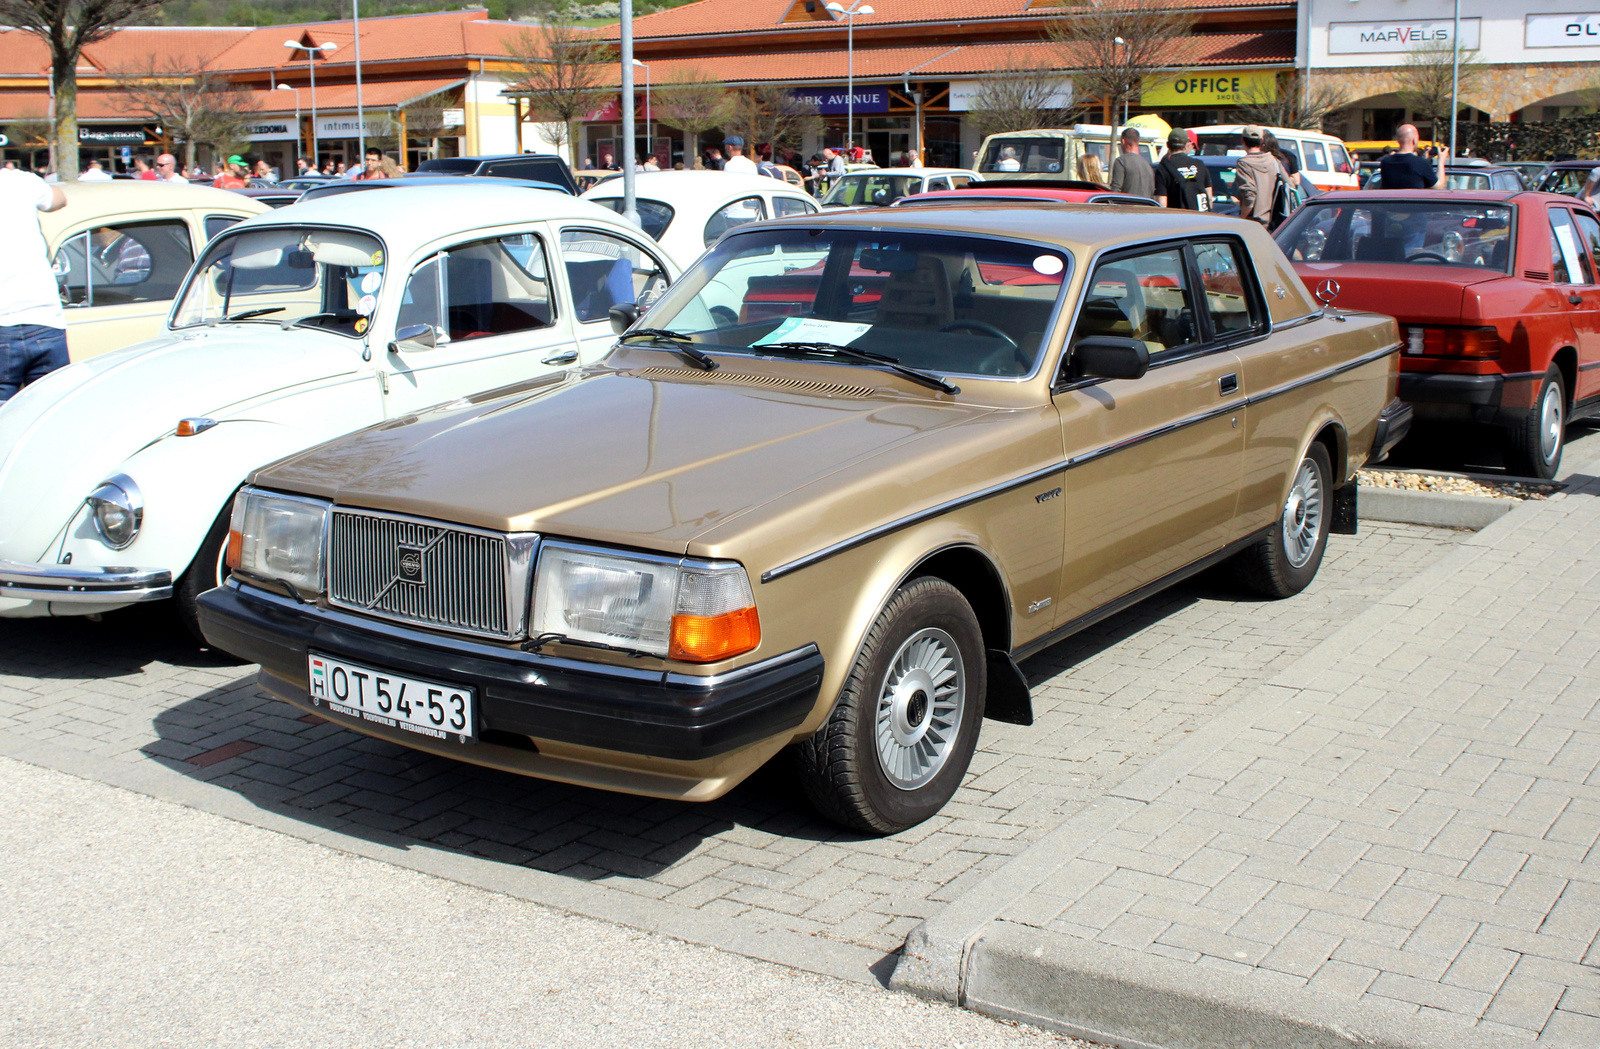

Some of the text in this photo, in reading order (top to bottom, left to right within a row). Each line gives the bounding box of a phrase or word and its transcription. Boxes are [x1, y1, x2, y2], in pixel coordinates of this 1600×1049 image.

[1566, 23, 1600, 36] OL
[1175, 77, 1240, 94] OFFICE
[788, 94, 880, 106] PARK AVENUE
[313, 677, 325, 696] H
